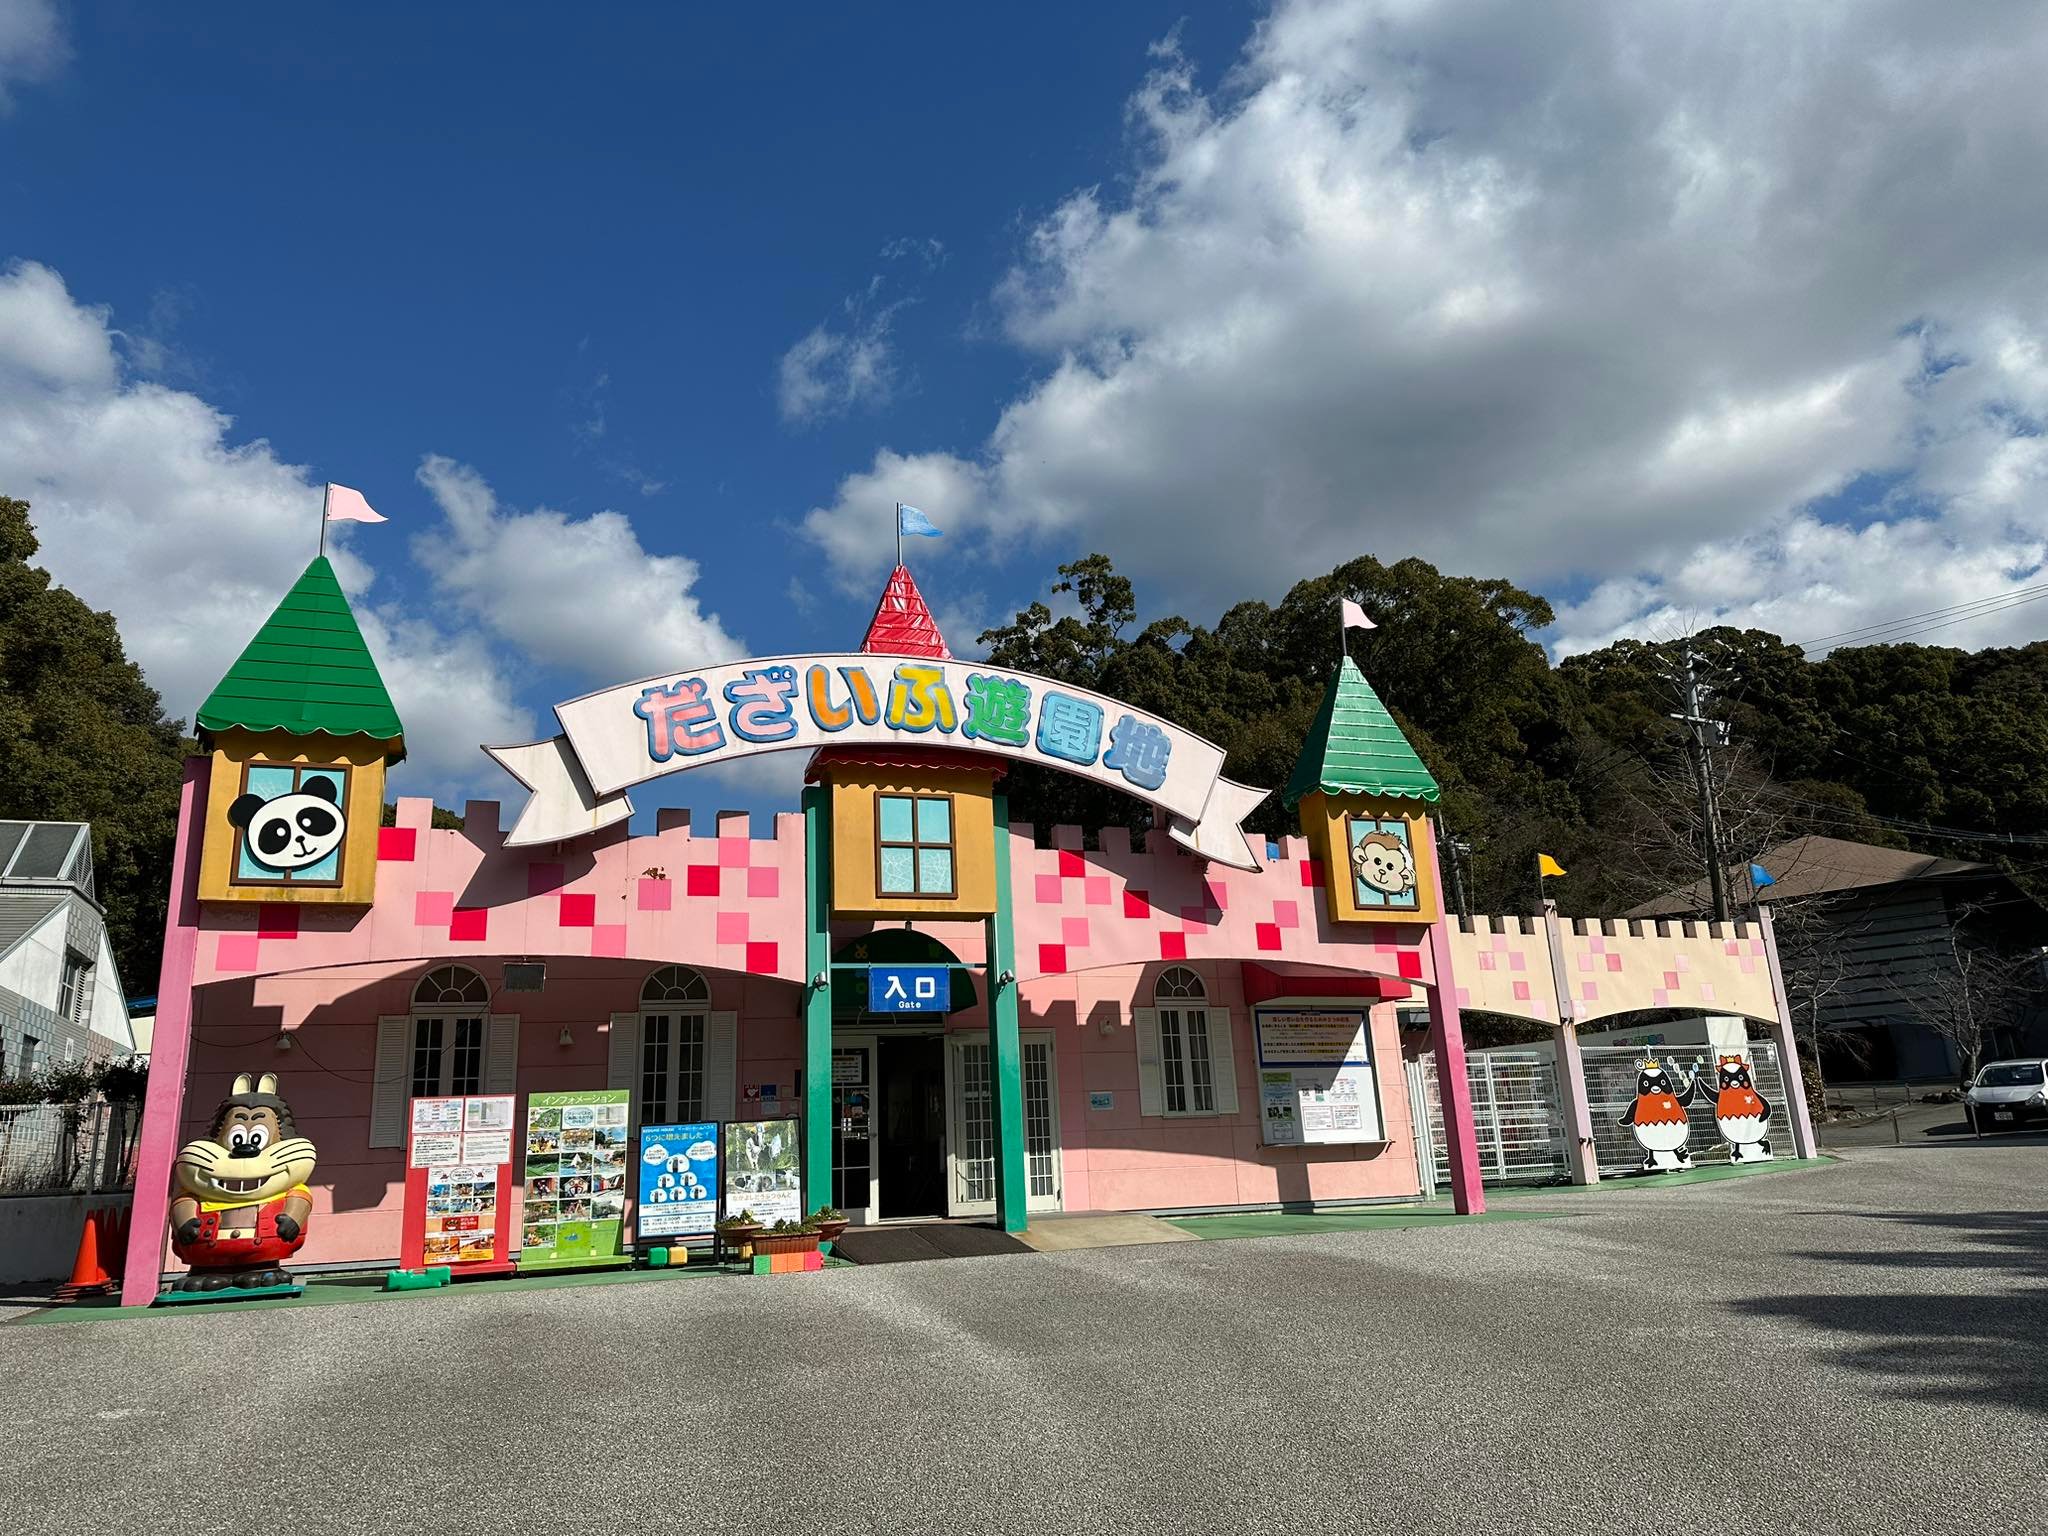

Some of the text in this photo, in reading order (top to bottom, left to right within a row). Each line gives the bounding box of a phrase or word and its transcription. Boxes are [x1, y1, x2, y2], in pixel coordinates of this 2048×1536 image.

[633, 663, 1172, 791] だざいふ遊園地
[884, 975, 936, 999] 入口
[898, 1001, 922, 1009] Gate
[542, 1094, 617, 1105] インフォメーション
